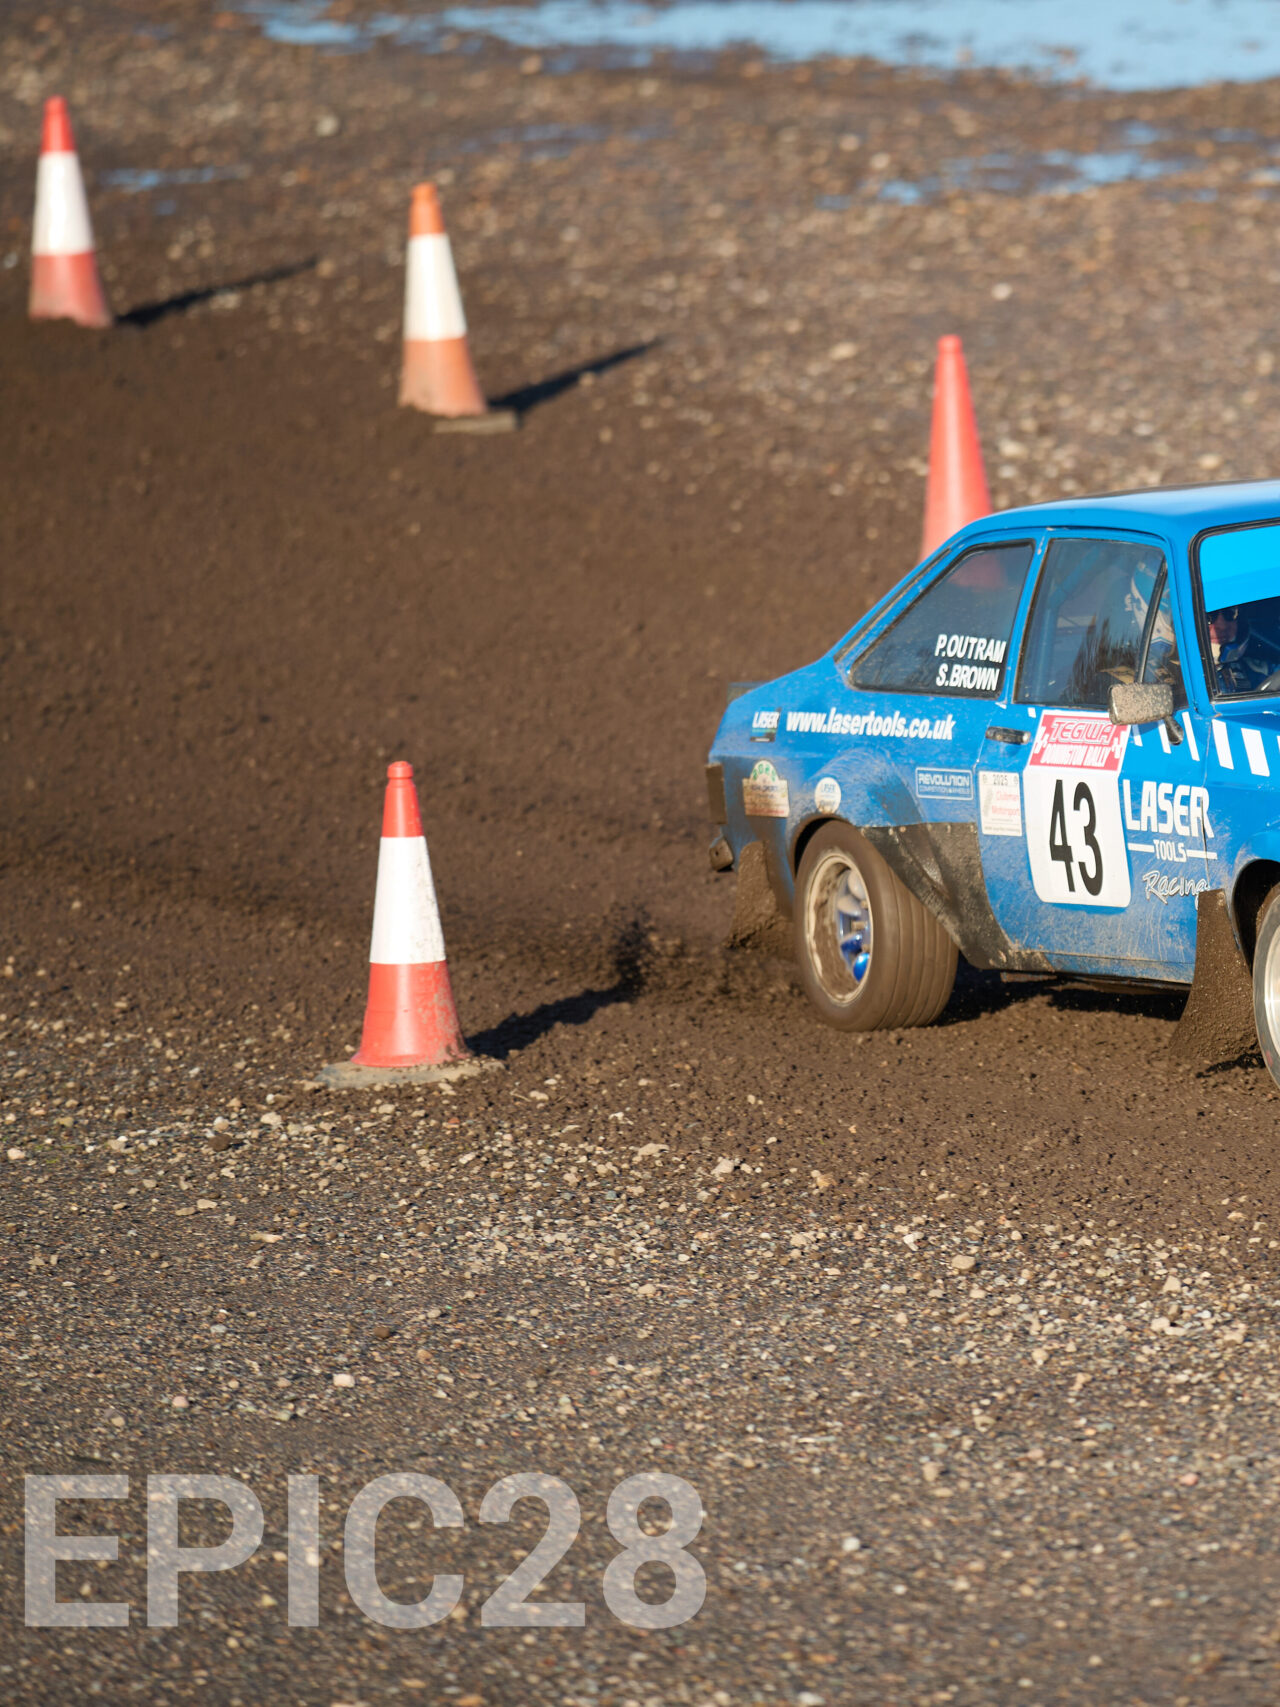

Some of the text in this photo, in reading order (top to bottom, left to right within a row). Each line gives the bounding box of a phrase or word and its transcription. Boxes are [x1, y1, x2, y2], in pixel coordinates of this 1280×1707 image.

[934, 634, 1007, 663] P.OUTRAM
[936, 663, 1000, 691] S.BROWN
[752, 711, 780, 729] LASER
[786, 707, 956, 740] www.lasertools.co.uk
[1048, 717, 1117, 745] TEGIWA
[918, 773, 970, 787] REVOLUTION
[992, 774, 1009, 786] 2025
[1122, 779, 1215, 838] LASER
[1049, 779, 1103, 896] 43
[1153, 840, 1187, 862] TOOLS
[1142, 870, 1210, 910] Racing
